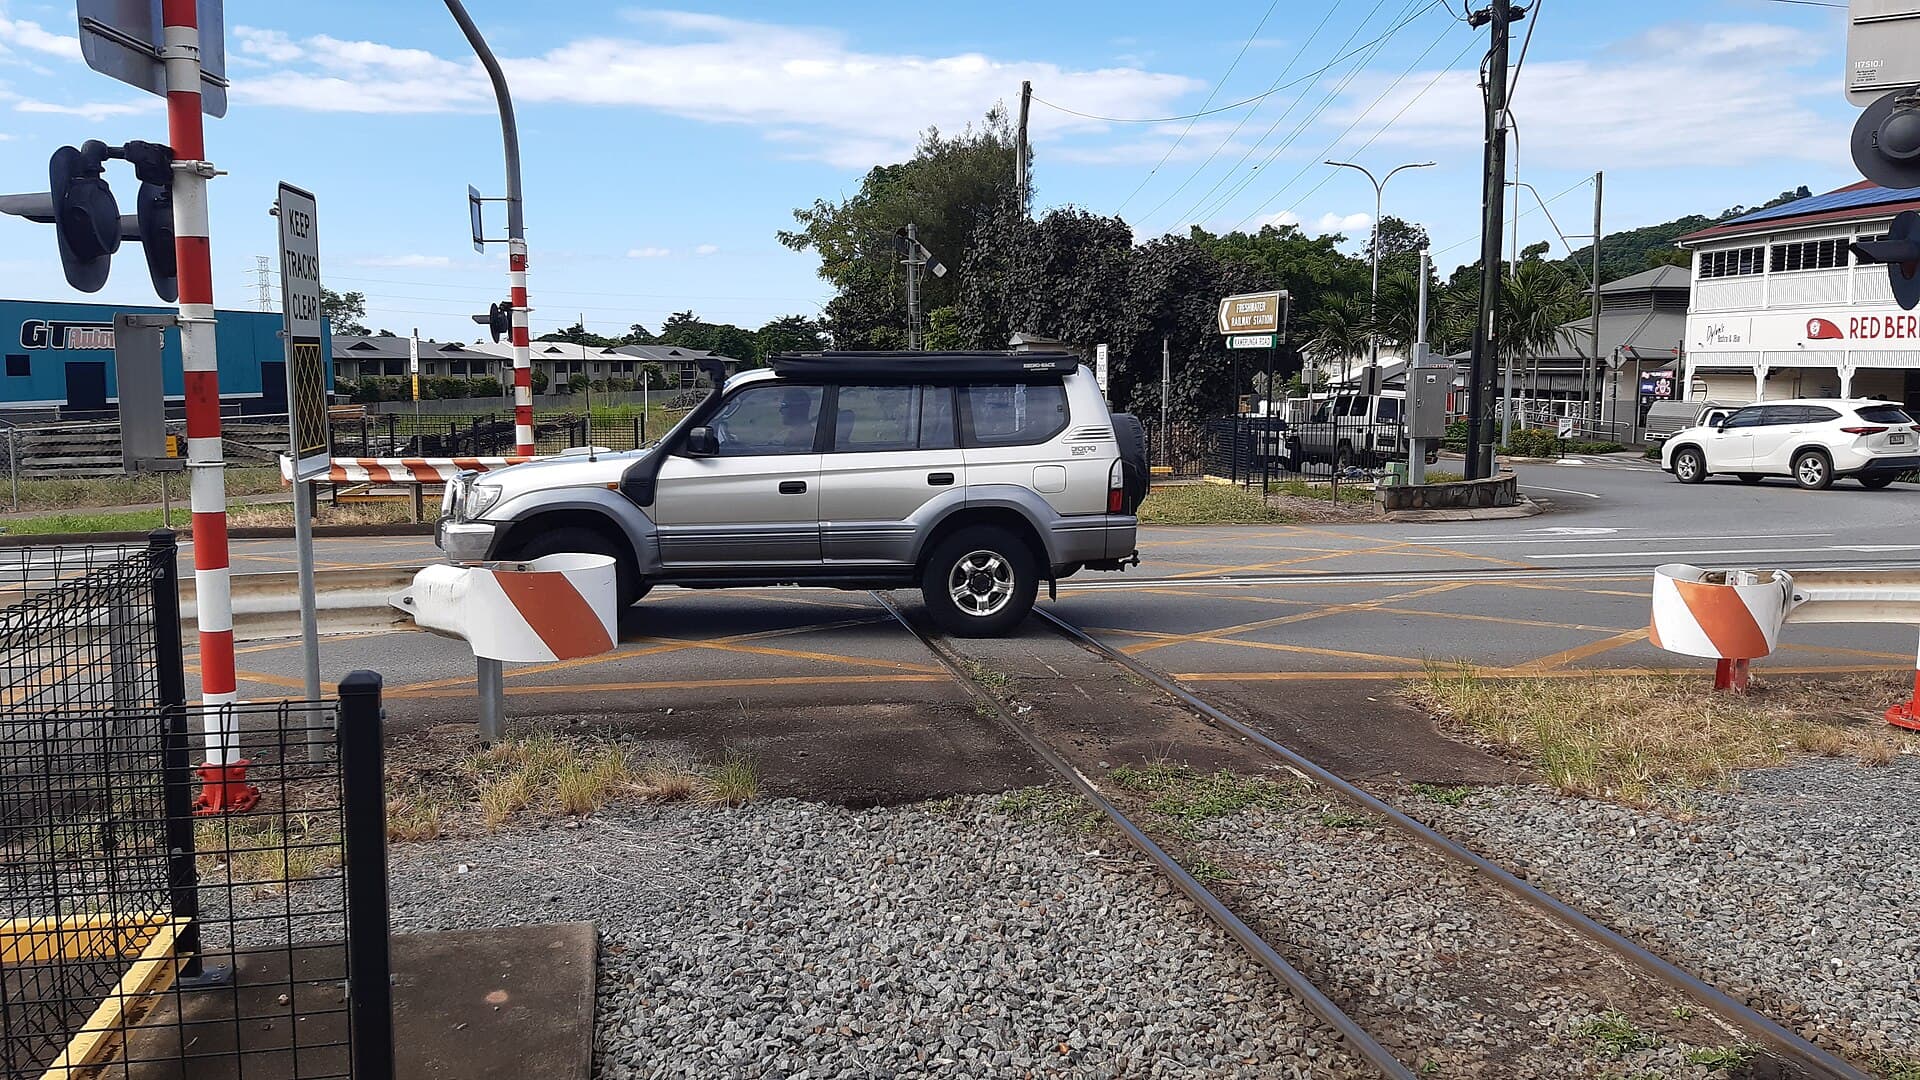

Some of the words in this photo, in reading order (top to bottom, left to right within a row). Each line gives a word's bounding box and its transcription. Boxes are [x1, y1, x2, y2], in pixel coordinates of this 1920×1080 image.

[288, 208, 311, 239] KEEP
[286, 249, 318, 281] TRACKS
[292, 293, 318, 320] CLEAR
[1236, 301, 1266, 313] FRESHWATER
[1231, 315, 1251, 327] RAILWAY
[1252, 314, 1273, 326] STATION
[1849, 316, 1881, 339] RED
[1884, 315, 1920, 339] BER
